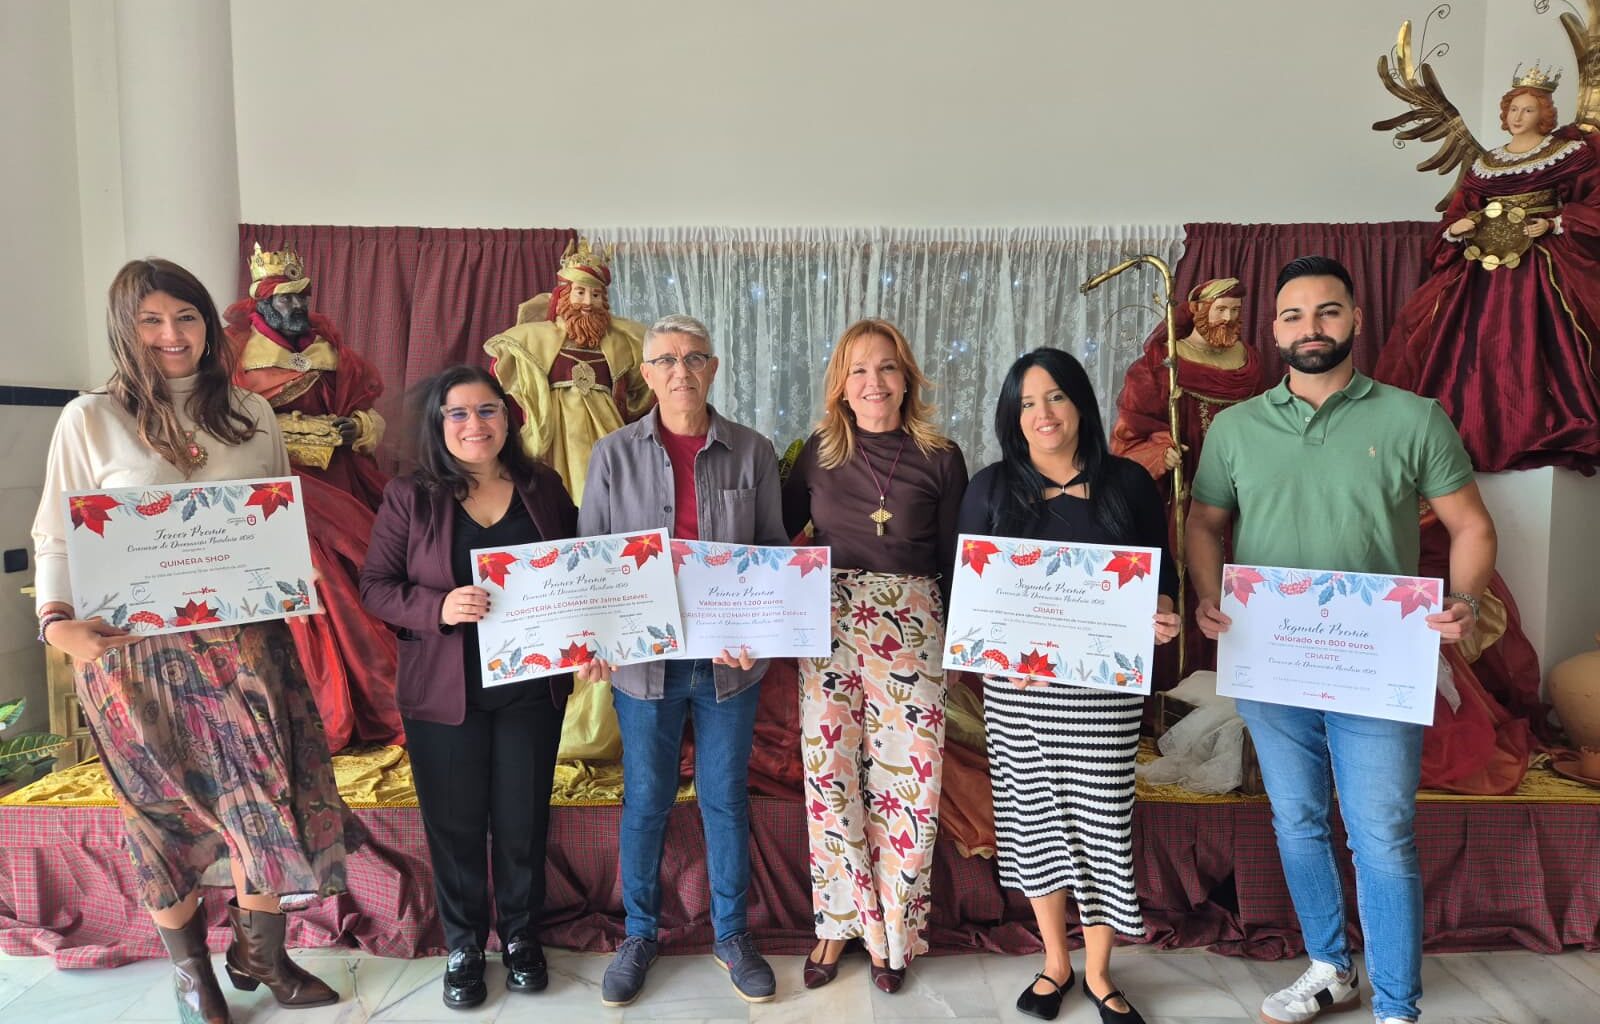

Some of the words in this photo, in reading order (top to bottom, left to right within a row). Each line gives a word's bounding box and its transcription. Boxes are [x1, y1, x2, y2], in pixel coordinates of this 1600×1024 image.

[154, 528, 188, 541] Tercer
[190, 525, 227, 537] Premio
[160, 558, 204, 568] QUIMERA
[205, 554, 230, 564] SHOP
[576, 573, 607, 584] Premio
[1015, 578, 1052, 592] Segundo
[1055, 582, 1086, 595] Premio
[506, 604, 552, 617] FLORISTERÍA
[553, 598, 588, 609] LEOMAMI
[600, 596, 622, 604] Jaime
[1032, 606, 1064, 616] CRIARTE
[1278, 618, 1325, 635] Segundo
[1328, 624, 1369, 638] Premio
[1274, 633, 1313, 644] Valorado
[1328, 638, 1346, 648] 800
[1348, 642, 1374, 650] euros
[1304, 652, 1340, 662] CRIARTE
